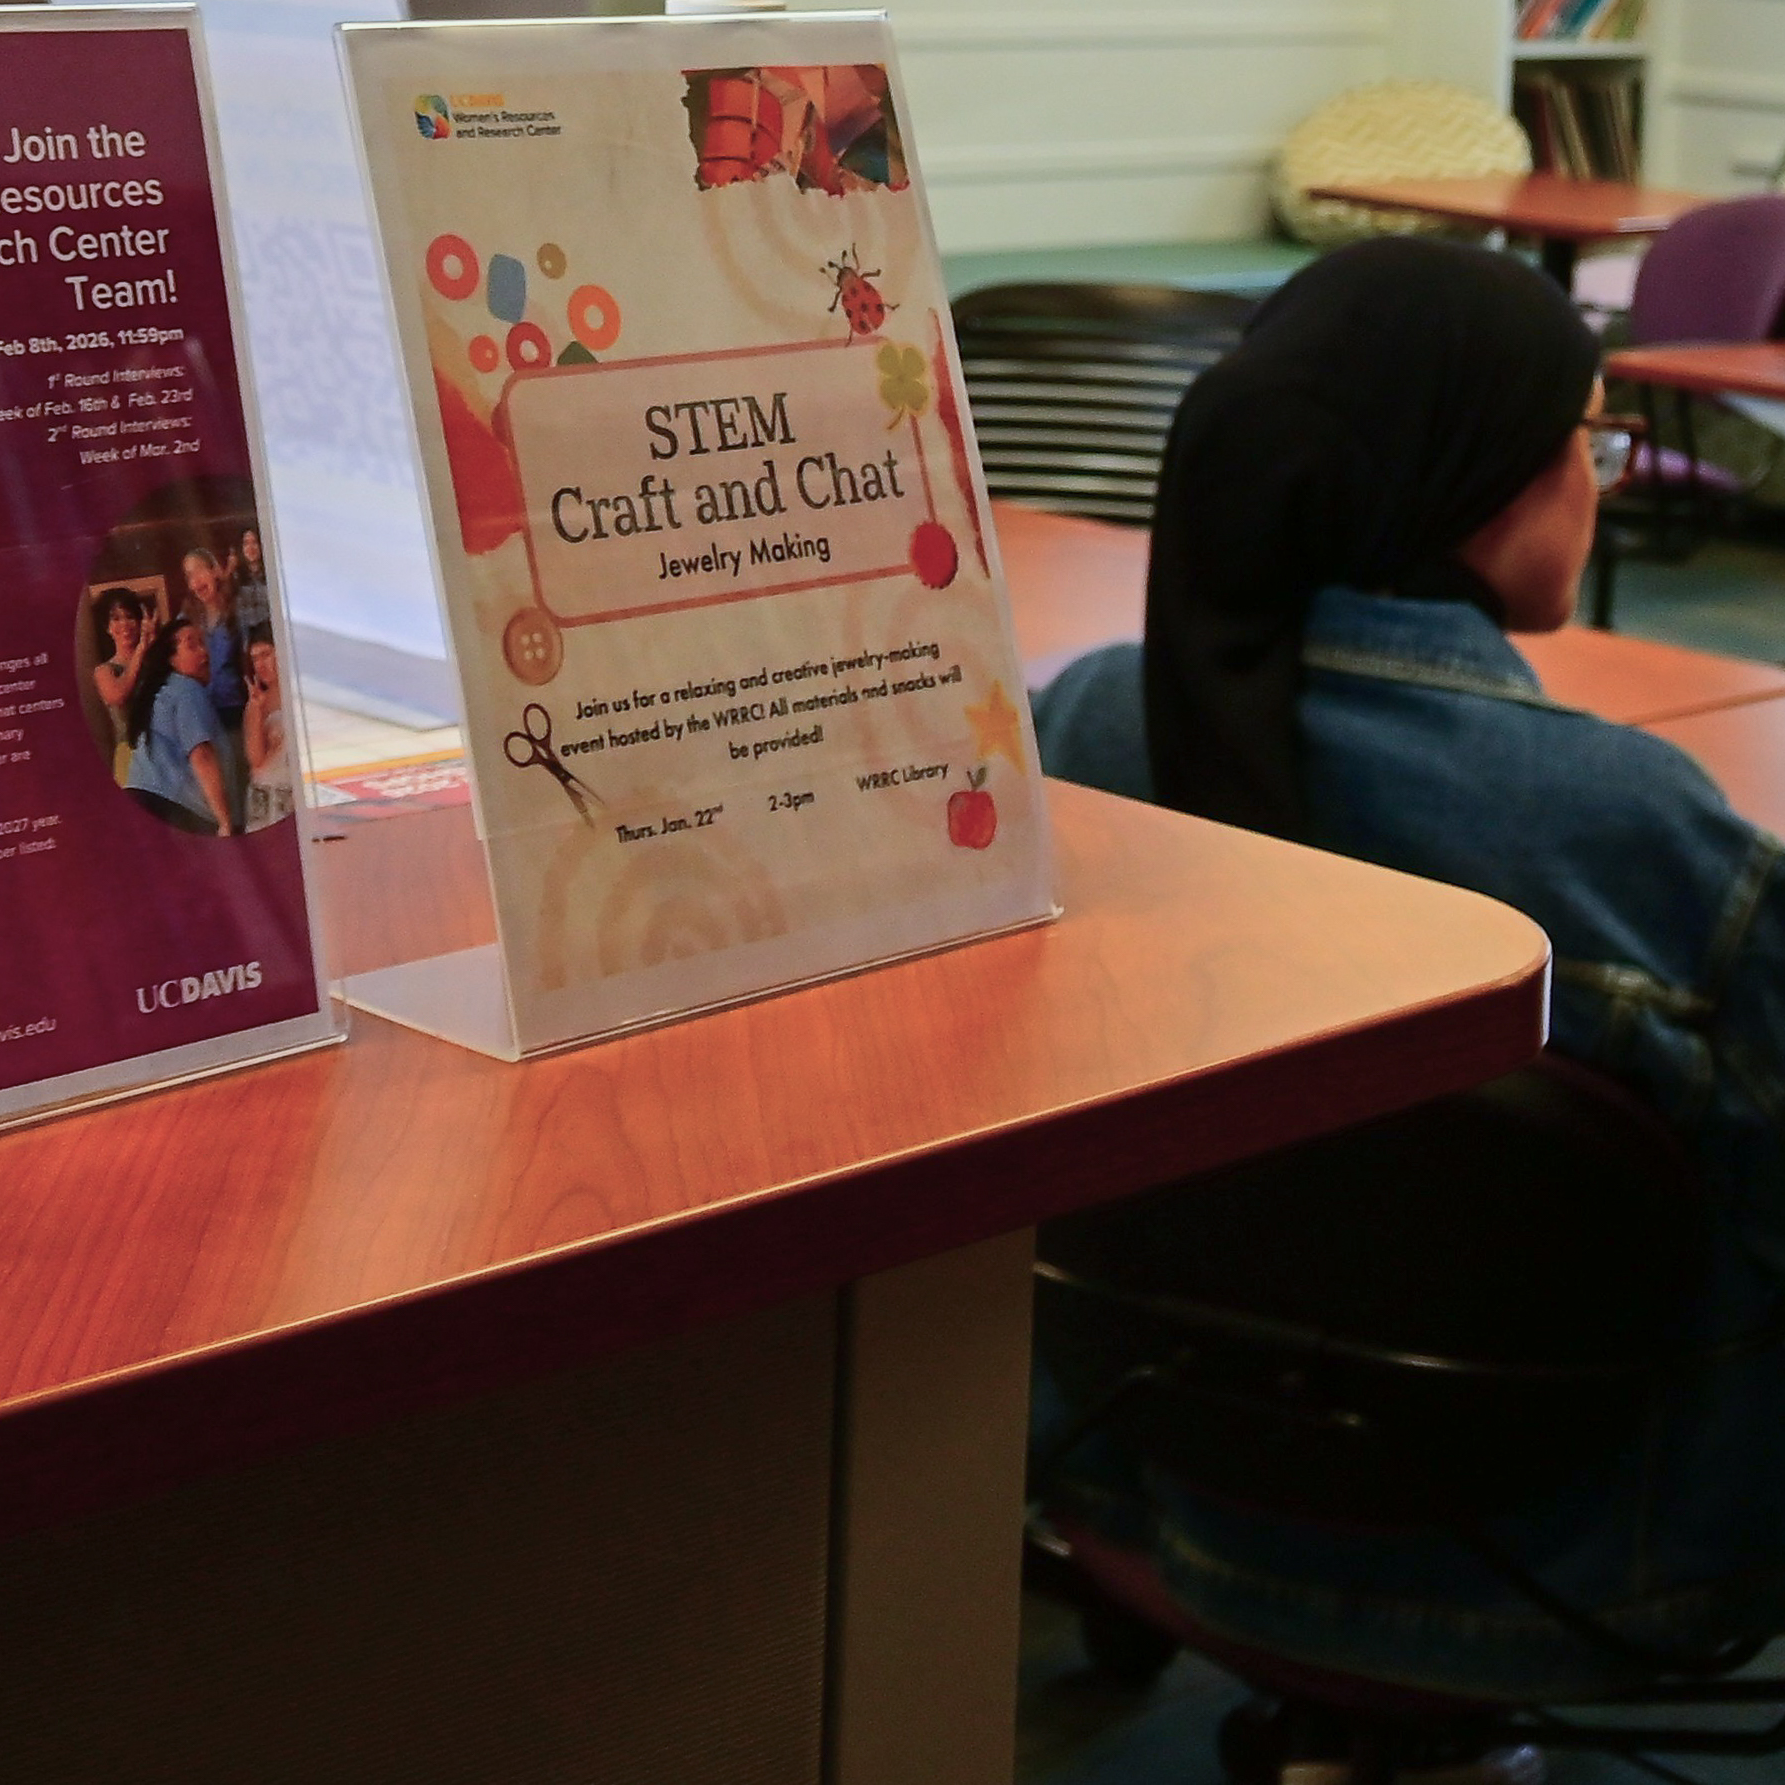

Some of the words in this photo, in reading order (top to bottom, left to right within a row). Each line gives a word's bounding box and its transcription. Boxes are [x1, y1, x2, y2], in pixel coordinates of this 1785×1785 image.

[3, 127, 78, 164] Join
[87, 124, 147, 158] the
[48, 225, 170, 262] Center
[64, 269, 178, 311] Team!
[29, 336, 63, 354] 8th,
[65, 332, 115, 350] 2026,
[117, 326, 184, 346] 11:59pm
[64, 371, 111, 388] Round
[112, 364, 185, 382] Interviews:
[25, 403, 43, 419] of
[44, 399, 75, 416] Feb.
[78, 395, 109, 412] 16th
[128, 391, 158, 408] Feb.
[160, 388, 193, 404] 23rd
[71, 421, 118, 440] Round
[119, 416, 193, 434] Interviews:
[644, 392, 796, 461] STEM
[79, 448, 120, 465] Week
[121, 445, 138, 461] of
[174, 438, 201, 455] 2nd
[550, 474, 682, 545] Craft
[694, 460, 787, 526] and
[796, 449, 906, 511] Chat
[658, 542, 742, 580] Jewelry
[750, 532, 832, 566] Making
[575, 699, 609, 721] Join
[612, 697, 631, 714] us
[632, 691, 658, 710] for
[661, 691, 671, 705] a
[673, 676, 737, 702] relaxing
[739, 670, 768, 690] and
[771, 660, 829, 685] creative
[831, 640, 941, 679] jewelry-making
[560, 734, 605, 758] event
[608, 722, 661, 748] hosted
[662, 718, 684, 742] by
[686, 710, 711, 733] the
[712, 703, 765, 730] WRRC!
[769, 697, 789, 720] All
[791, 686, 859, 715] materials
[891, 673, 937, 695] snacks
[938, 665, 962, 685] will
[727, 739, 750, 761] be
[752, 725, 824, 760] provided!
[615, 820, 658, 845] Thurs.
[660, 815, 692, 836] Jan.
[767, 790, 815, 816] 2-3pm
[855, 770, 901, 792] WRRC
[902, 762, 950, 785] Library
